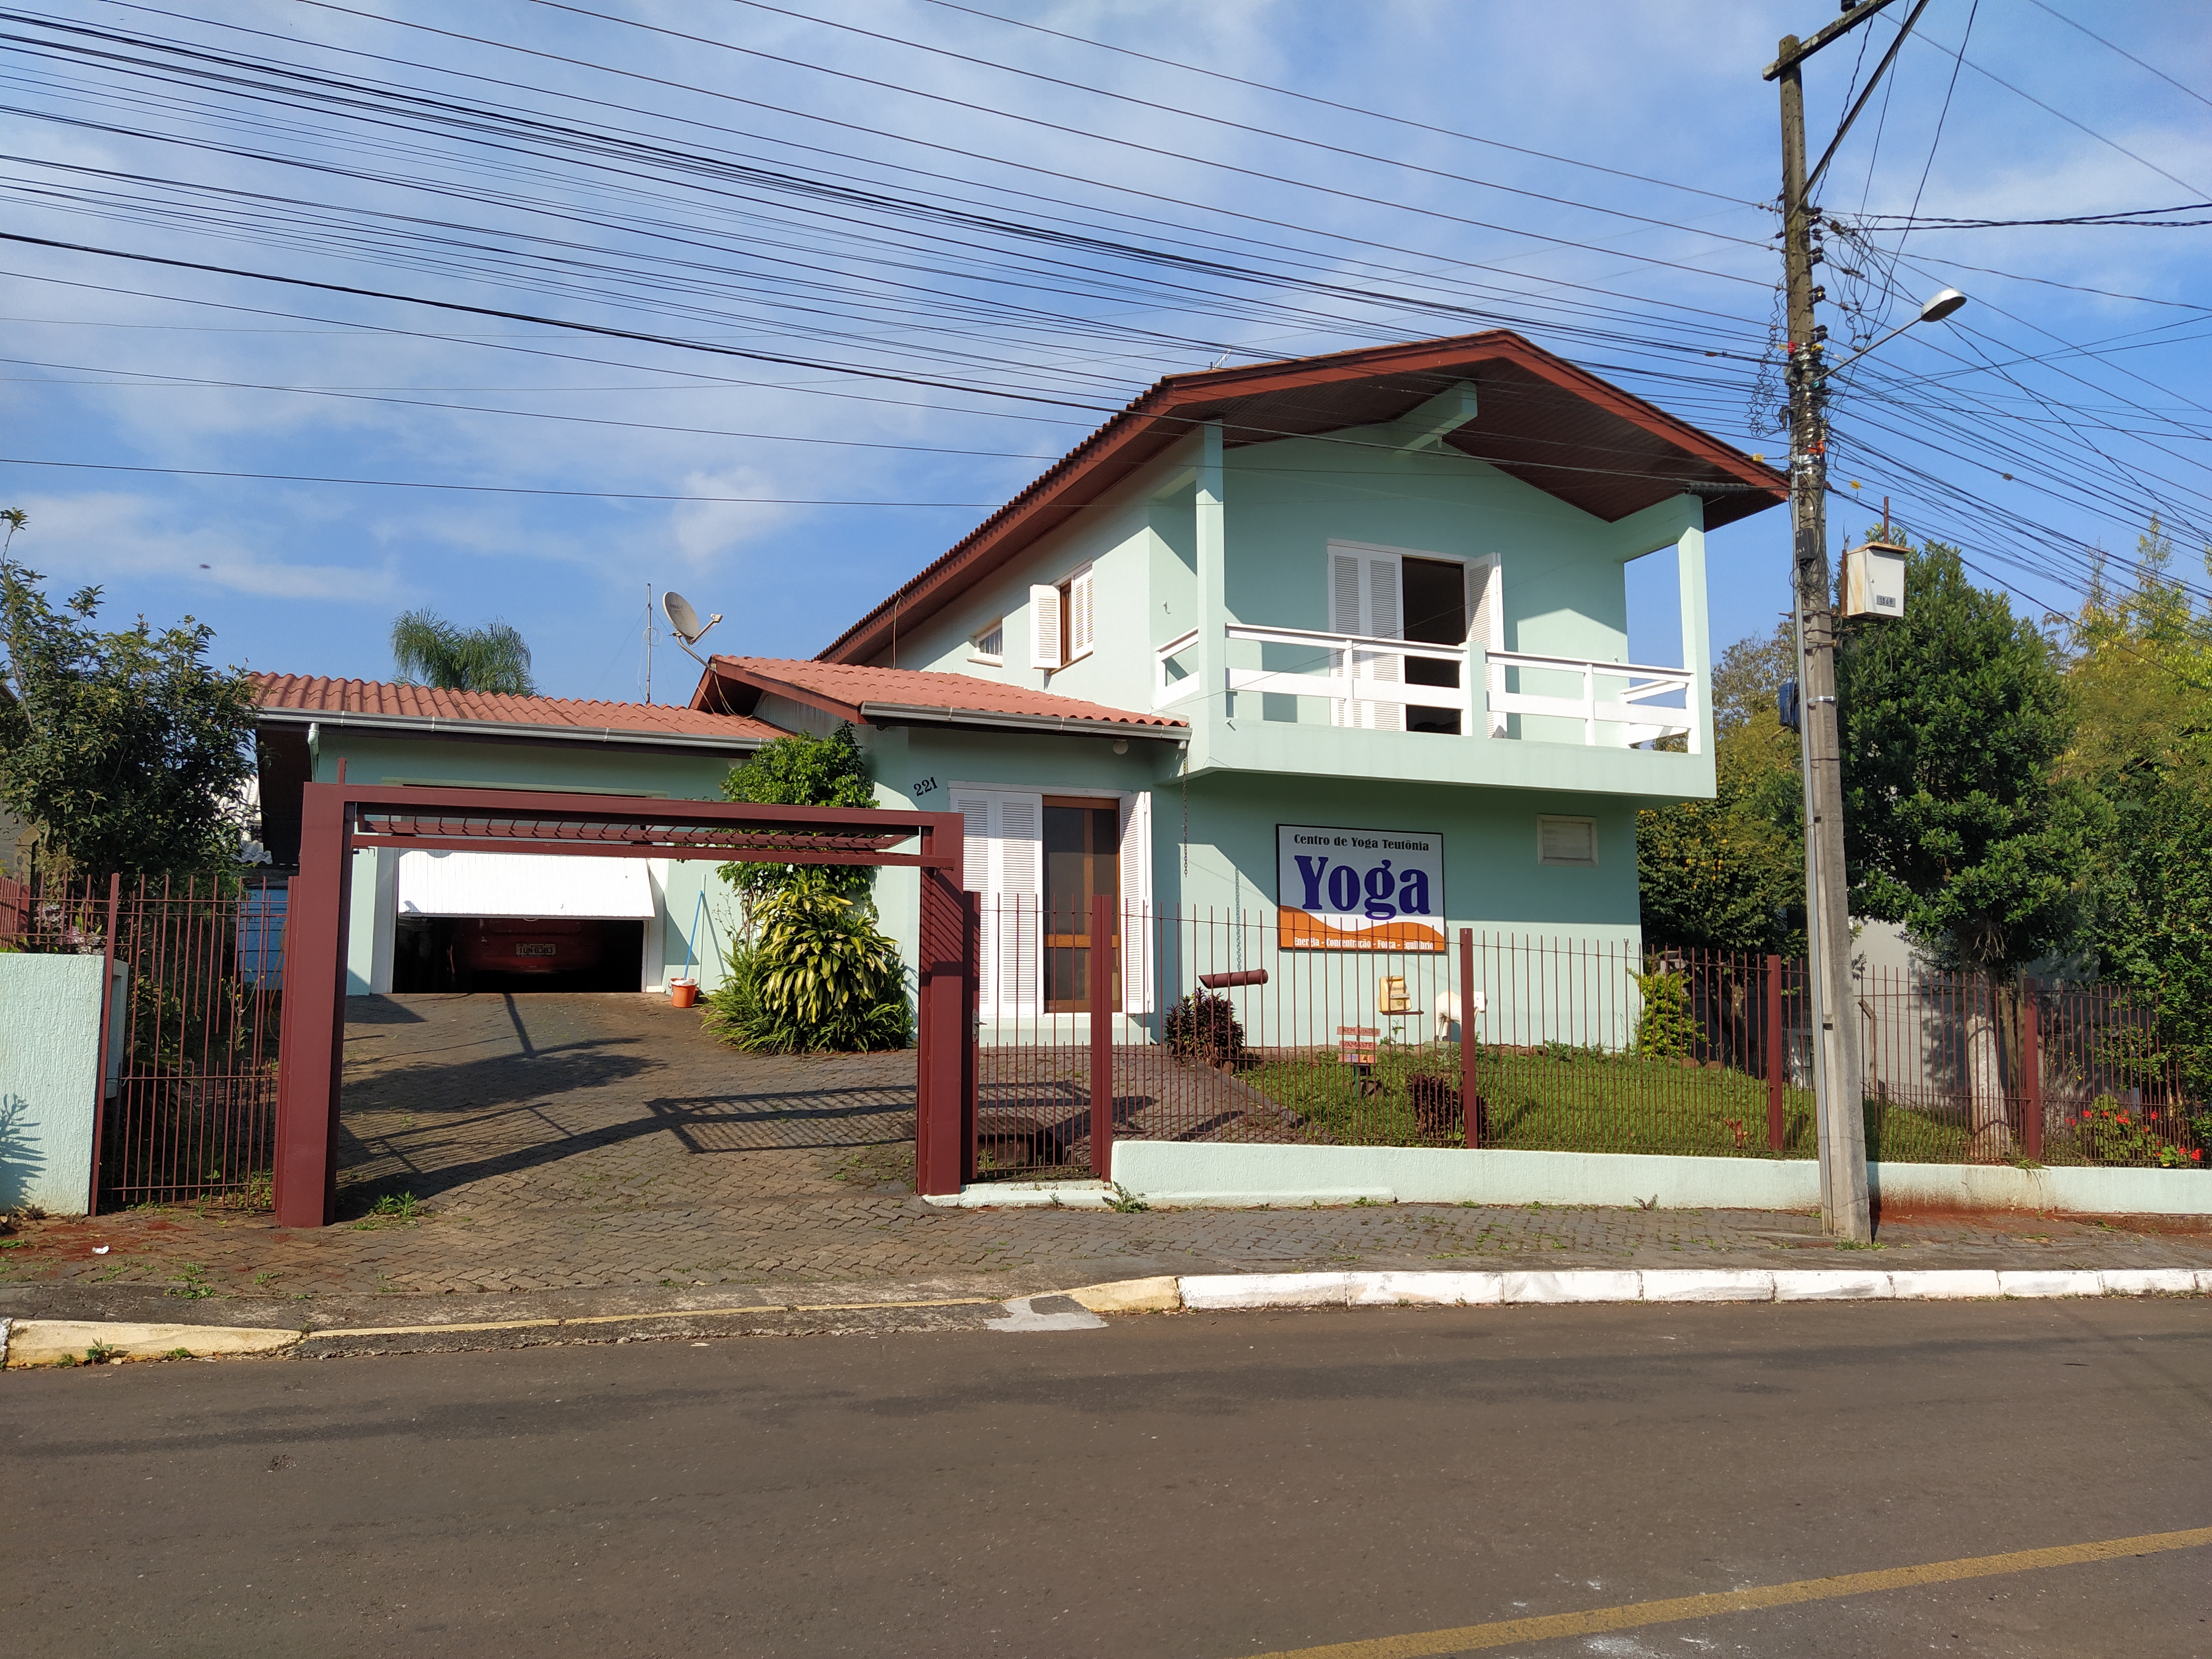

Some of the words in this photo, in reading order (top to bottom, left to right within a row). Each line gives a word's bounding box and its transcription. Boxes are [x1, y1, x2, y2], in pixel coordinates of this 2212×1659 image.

[913, 776, 938, 797] 221
[1294, 834, 1330, 846] Centro
[1334, 836, 1348, 847] de
[1352, 837, 1378, 849] Yoga
[1382, 839, 1429, 851] Teutônia
[1294, 855, 1431, 920] Yoga
[1294, 936, 1320, 947] Energia
[1377, 940, 1396, 950] Força
